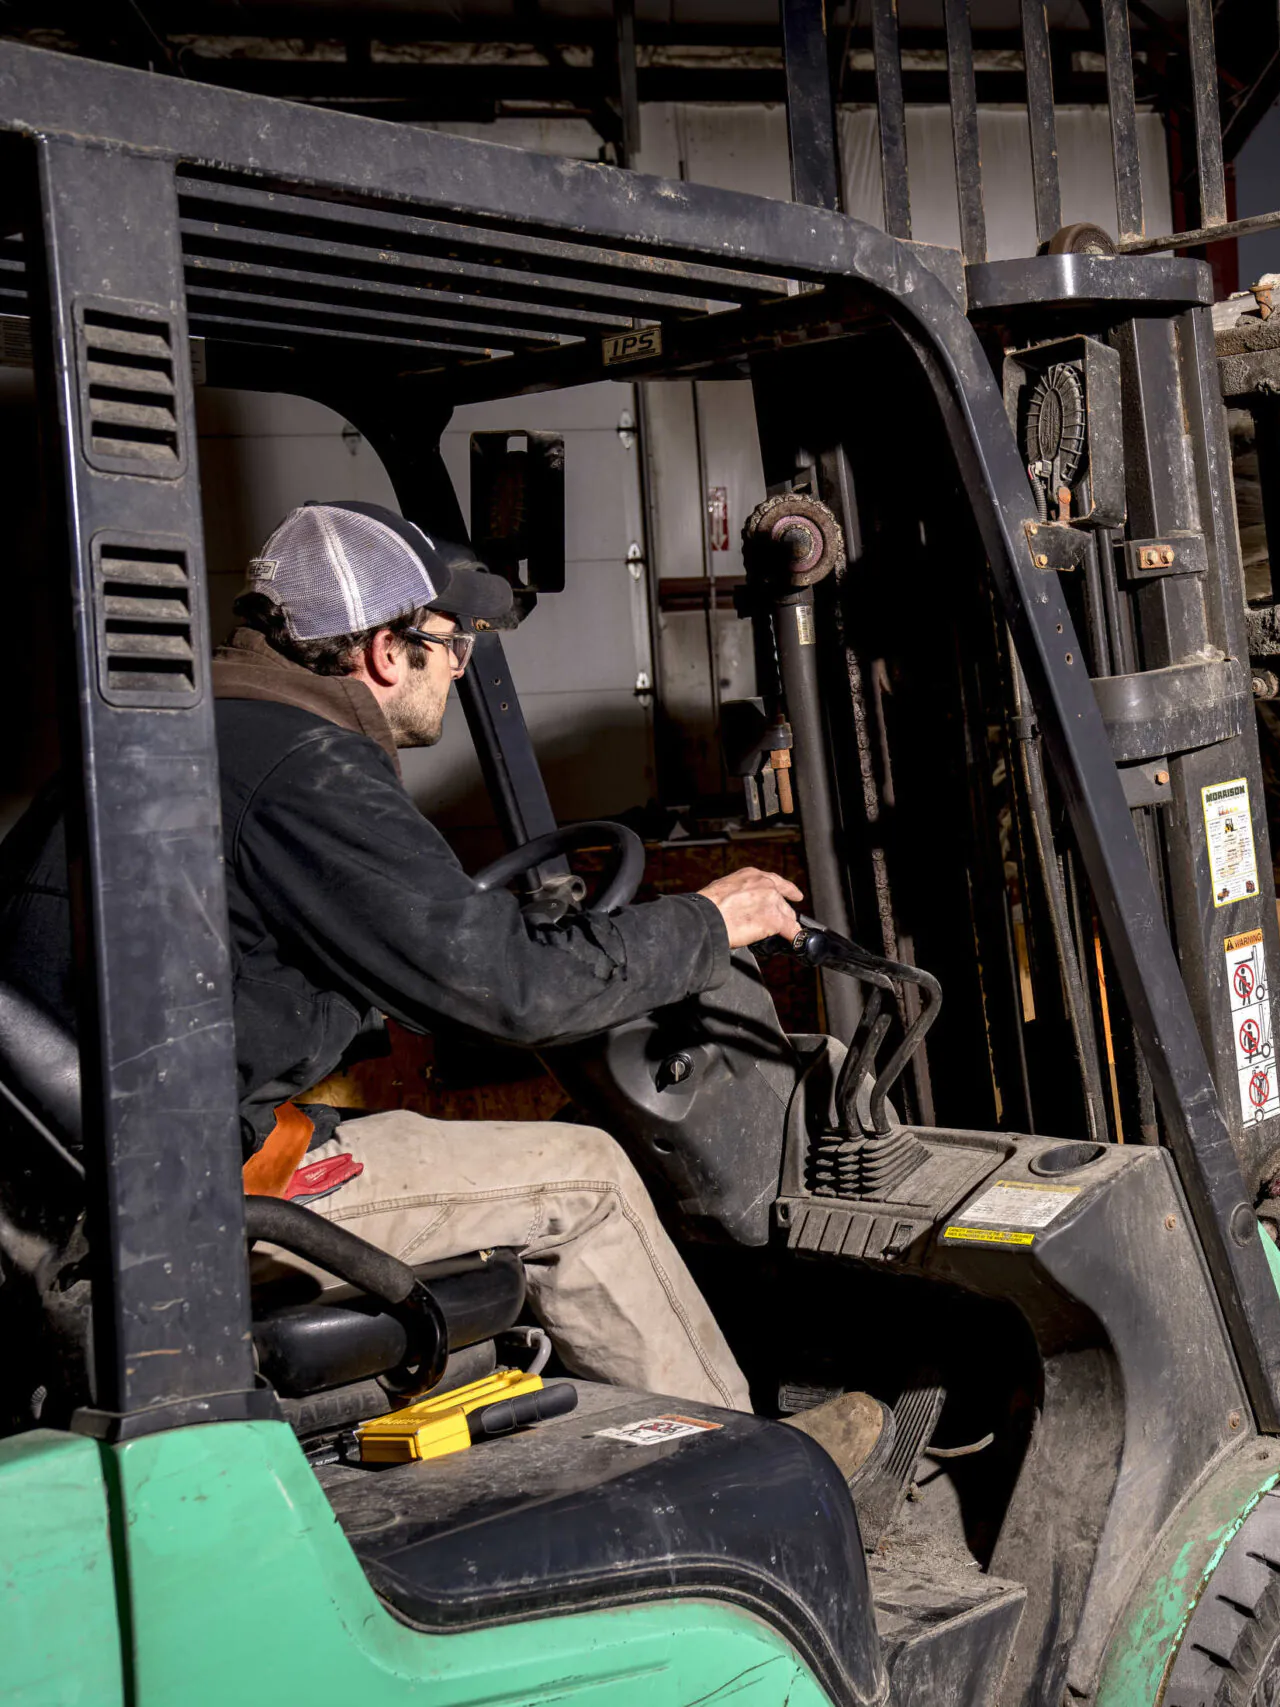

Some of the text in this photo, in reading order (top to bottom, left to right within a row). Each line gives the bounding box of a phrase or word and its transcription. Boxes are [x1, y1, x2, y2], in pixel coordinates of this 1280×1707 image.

[613, 332, 654, 356] IPS
[1205, 785, 1245, 802] MORRISON
[1234, 932, 1262, 948] WARNING
